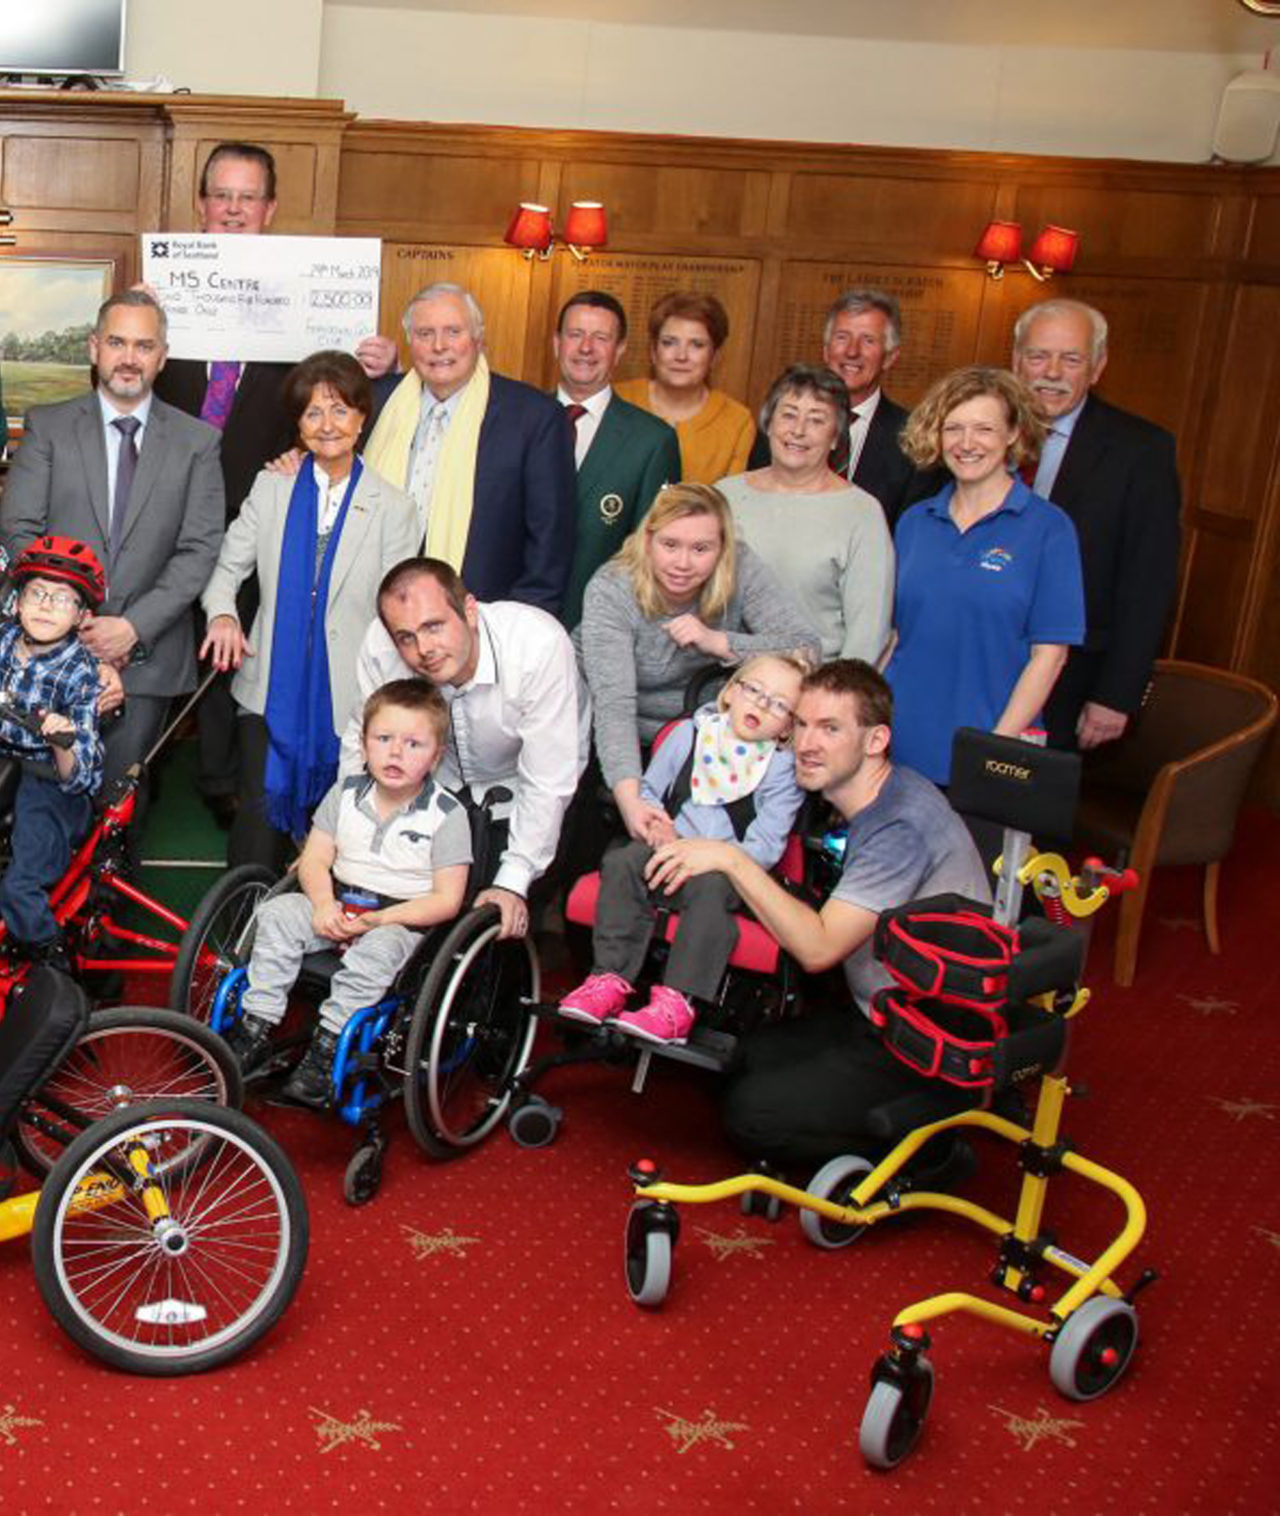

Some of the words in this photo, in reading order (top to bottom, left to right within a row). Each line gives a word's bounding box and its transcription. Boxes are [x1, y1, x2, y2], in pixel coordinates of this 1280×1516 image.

[173, 240, 194, 249] Royal
[183, 251, 219, 259] Scotland
[170, 271, 200, 289] MS
